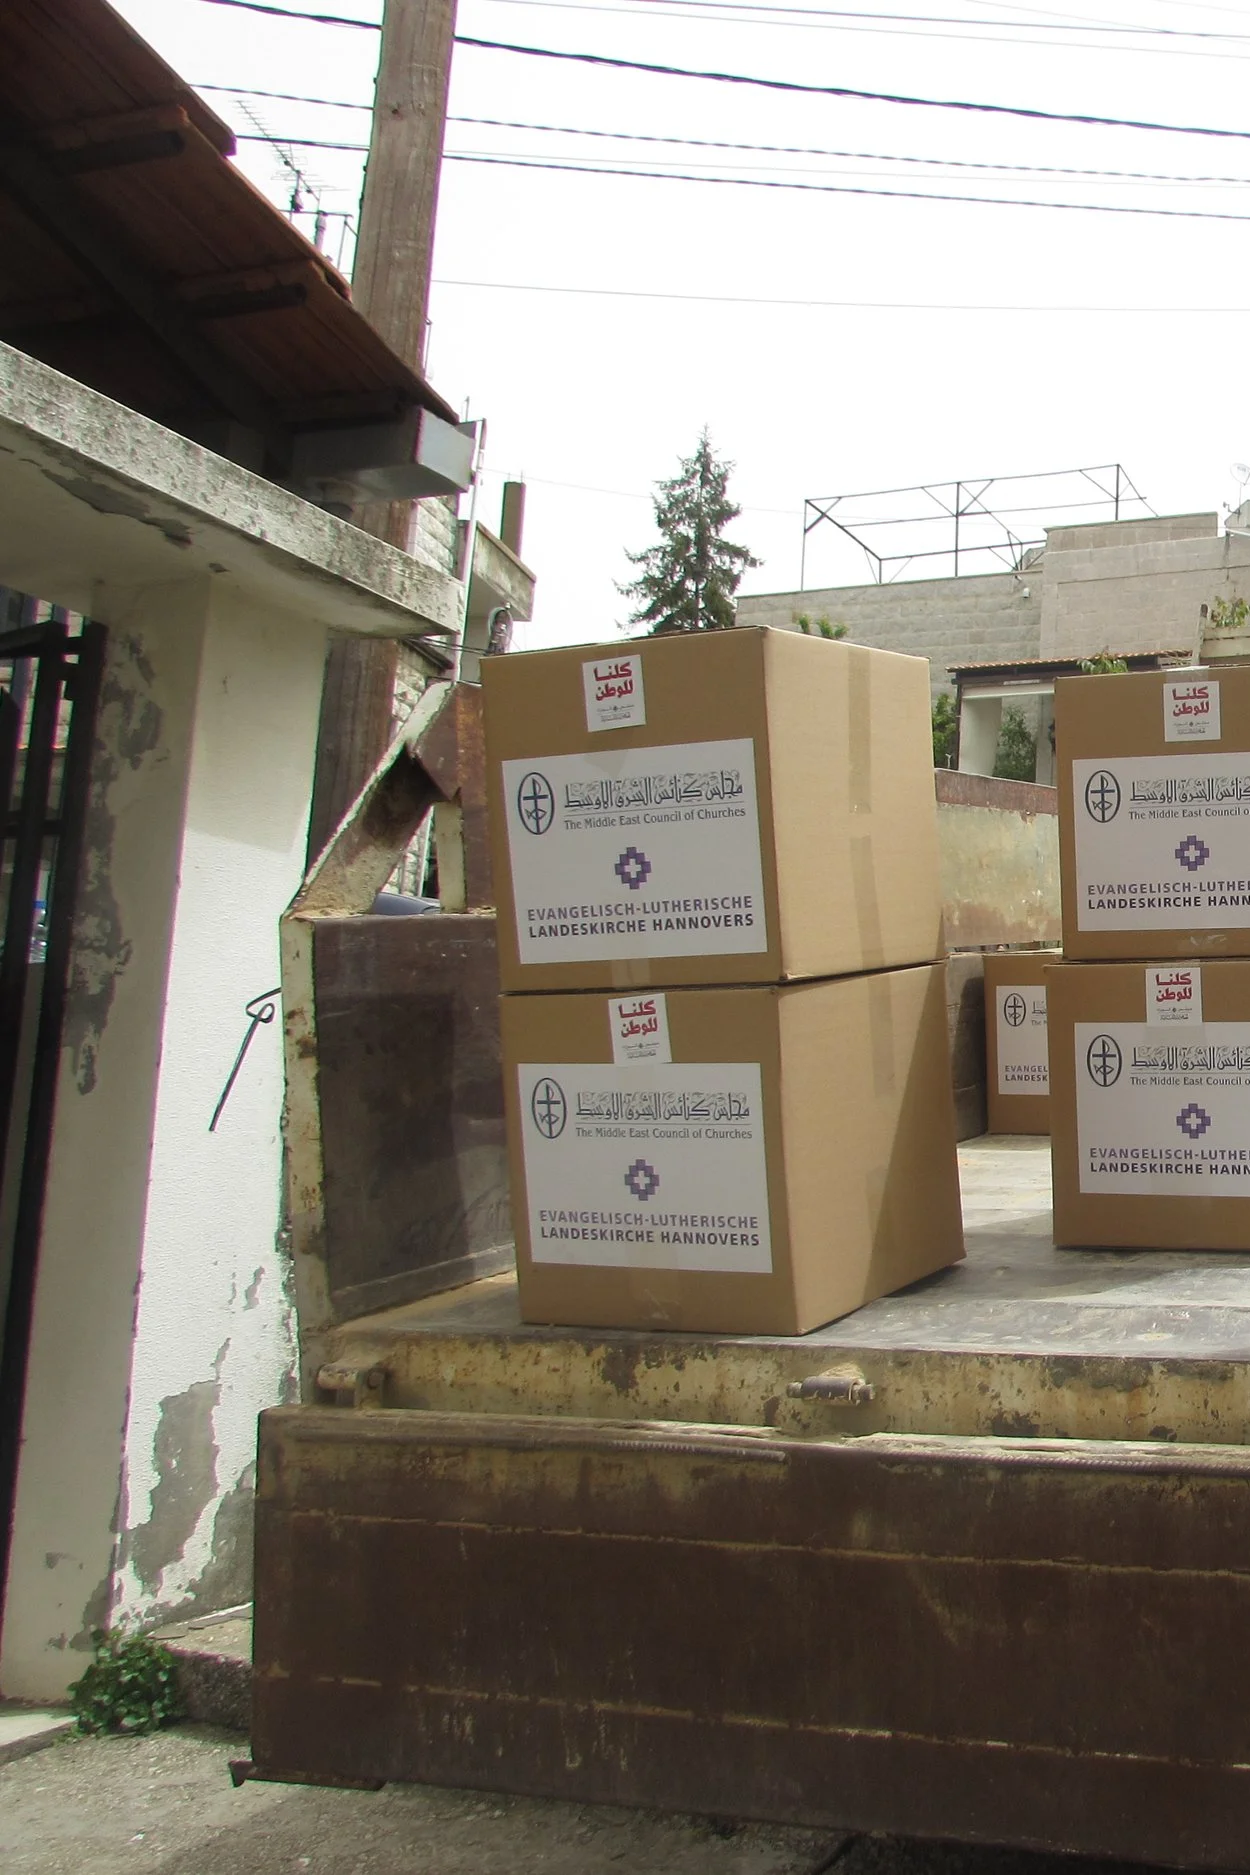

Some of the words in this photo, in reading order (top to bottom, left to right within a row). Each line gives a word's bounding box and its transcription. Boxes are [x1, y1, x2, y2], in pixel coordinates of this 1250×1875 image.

[593, 662, 632, 681] كلنا
[596, 679, 633, 701] للوطن
[1172, 686, 1209, 700] كلنا
[1173, 701, 1209, 716] للوطن
[564, 820, 582, 830] The
[584, 817, 616, 828] Middle
[619, 815, 640, 826] East
[644, 811, 681, 824] Council
[684, 810, 694, 820] of
[697, 807, 746, 819] Churches
[1129, 811, 1145, 820] The
[1148, 810, 1179, 819] Middle
[1182, 809, 1201, 817] East
[1205, 807, 1240, 816] Council
[528, 896, 752, 921] EVANGELISCH-LUTHERISCHE
[1088, 897, 1201, 909] LANDESKIRCHE
[529, 920, 646, 938] LANDESKIRCHE
[653, 914, 754, 930] HANNOVERS
[1155, 972, 1192, 985] كلنا
[1156, 987, 1192, 1002] للوطن
[618, 1000, 656, 1018] كلنا
[621, 1017, 657, 1037] للوطن
[1005, 1065, 1048, 1073] EVANGEL
[1005, 1074, 1048, 1082] LANDESK
[1130, 1077, 1147, 1085] The
[1150, 1077, 1180, 1085] Middle
[1183, 1077, 1202, 1085] East
[1206, 1077, 1241, 1085] Council
[576, 1128, 592, 1137] The
[596, 1128, 626, 1138] Middle
[630, 1128, 649, 1138] East
[653, 1128, 689, 1138] Council
[693, 1128, 702, 1138] of
[705, 1128, 752, 1139] Churches
[1091, 1163, 1203, 1174] LANDESKIRCHE
[540, 1210, 758, 1228] EVANGELISCH-LUTHERISCHE
[541, 1227, 654, 1242] LANDESKIRCHE
[661, 1232, 760, 1246] HANNOVERS
